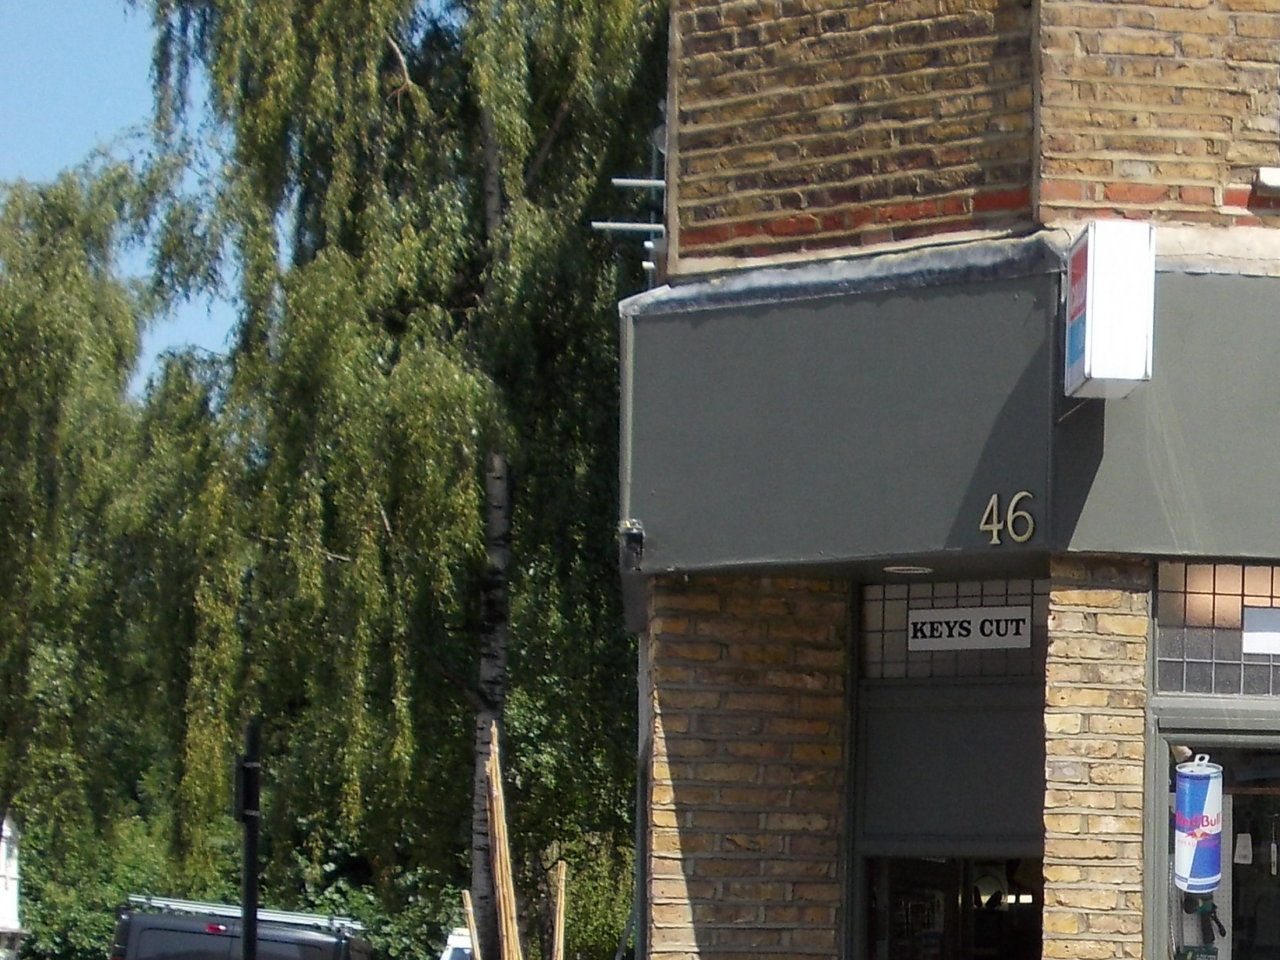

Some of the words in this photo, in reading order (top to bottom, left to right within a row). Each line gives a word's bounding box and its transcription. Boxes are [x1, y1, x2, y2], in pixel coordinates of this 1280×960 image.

[979, 491, 1034, 545] 46
[911, 620, 972, 640] KEYS
[979, 618, 1026, 638] CUT
[1176, 811, 1200, 828] Red
[1201, 812, 1221, 828] Bull
